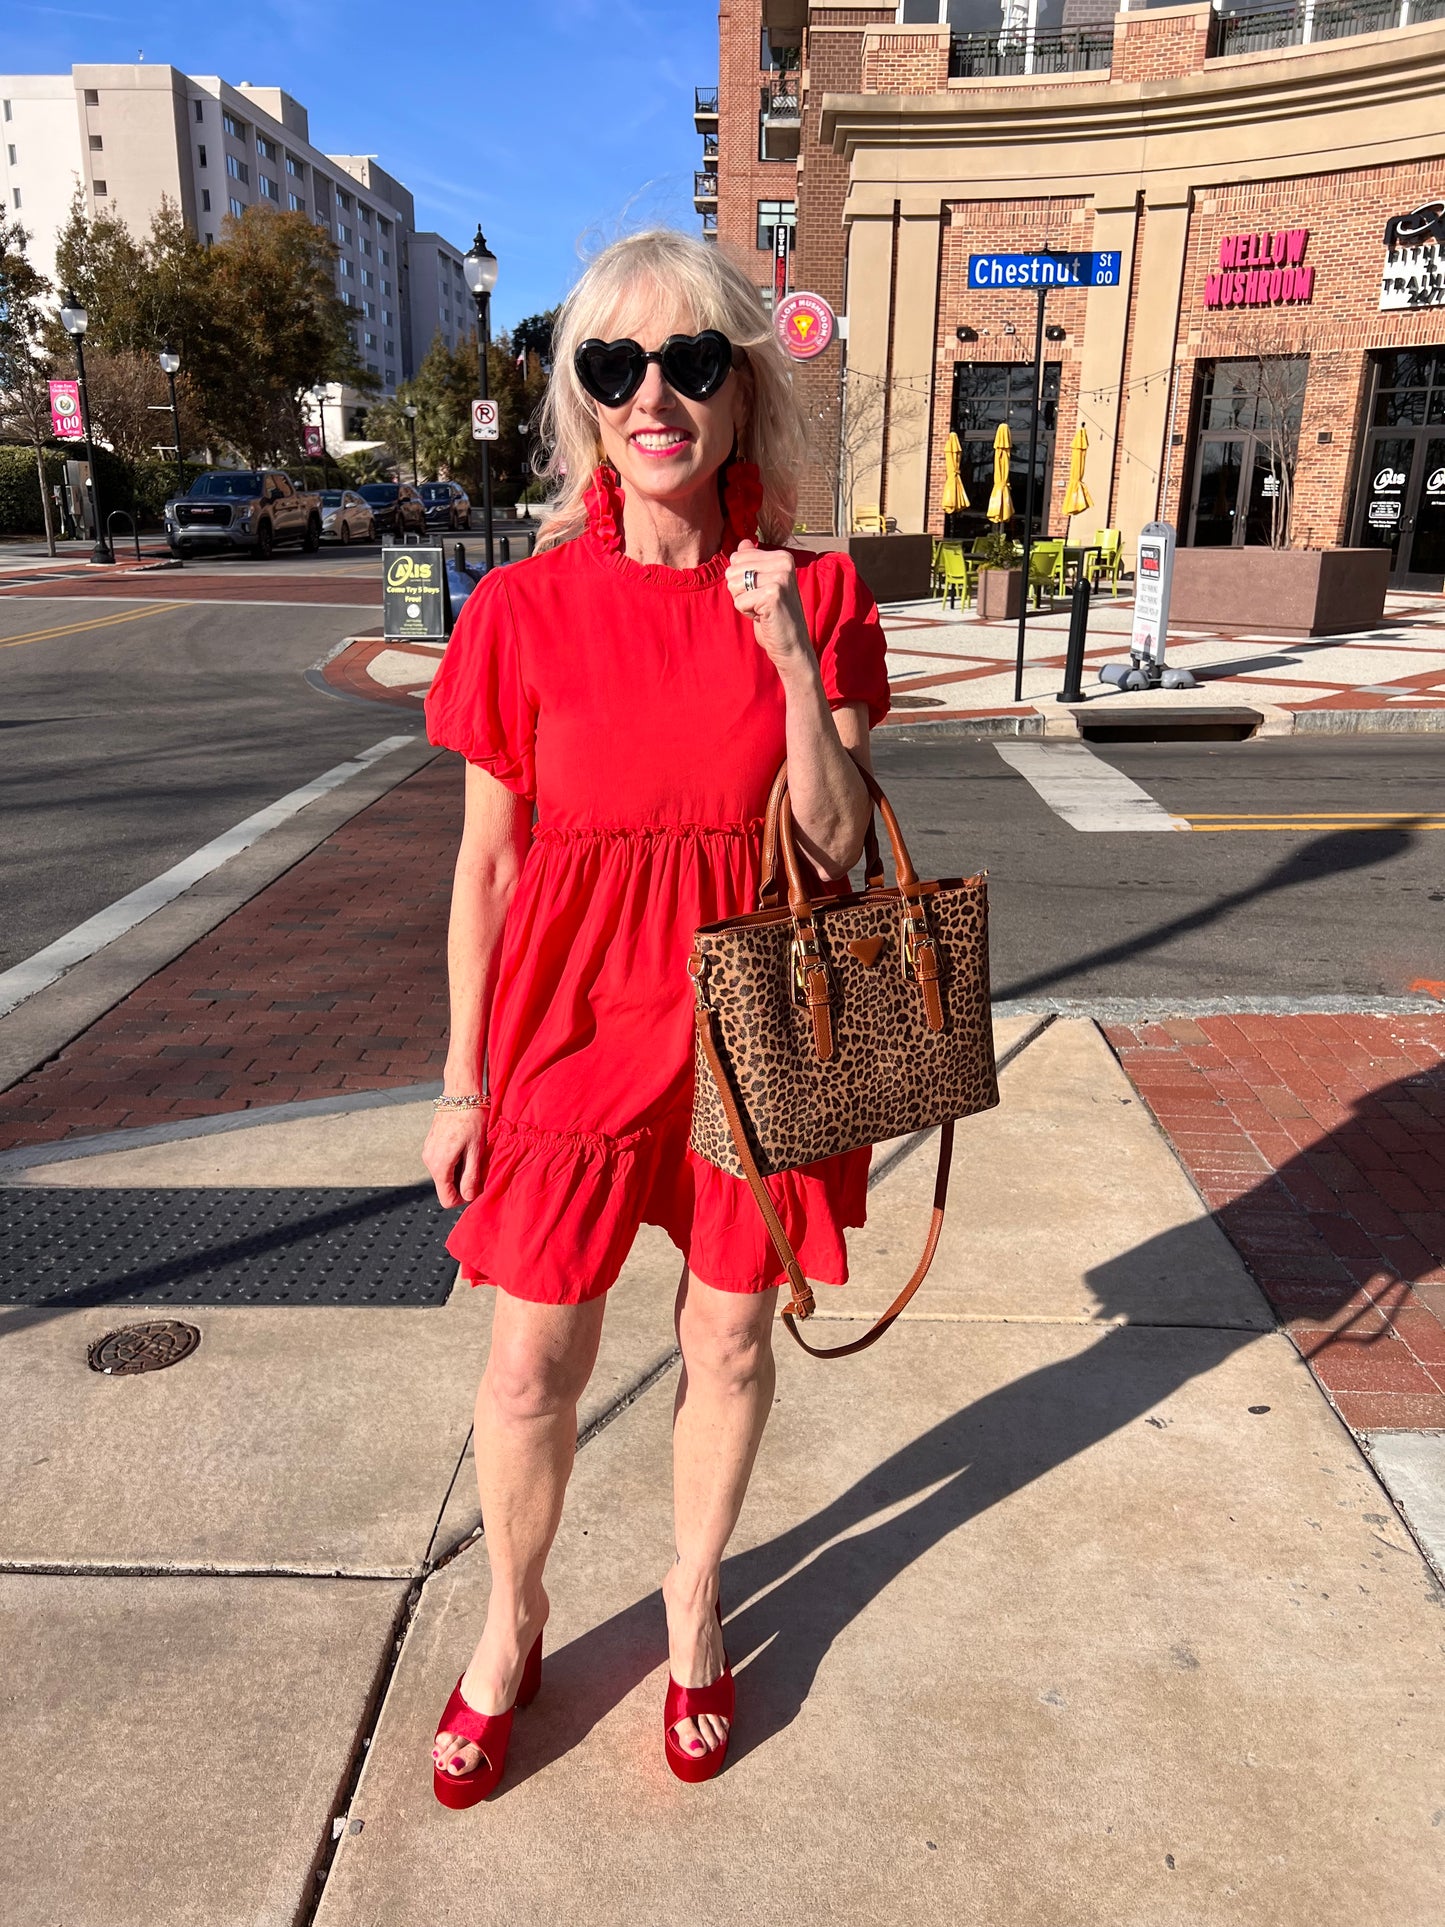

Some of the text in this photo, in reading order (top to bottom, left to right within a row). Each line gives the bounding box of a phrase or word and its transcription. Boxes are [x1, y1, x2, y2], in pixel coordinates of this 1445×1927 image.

[1219, 228, 1308, 268] MELLOW
[974, 253, 1113, 284] Chestnut St
[1096, 271, 1113, 284] 00
[1204, 266, 1314, 307] MUSHROOM
[778, 299, 829, 337] MELLOW MUSHROOM
[55, 415, 79, 432] 100
[406, 586, 417, 595] Try
[423, 586, 440, 595] Days
